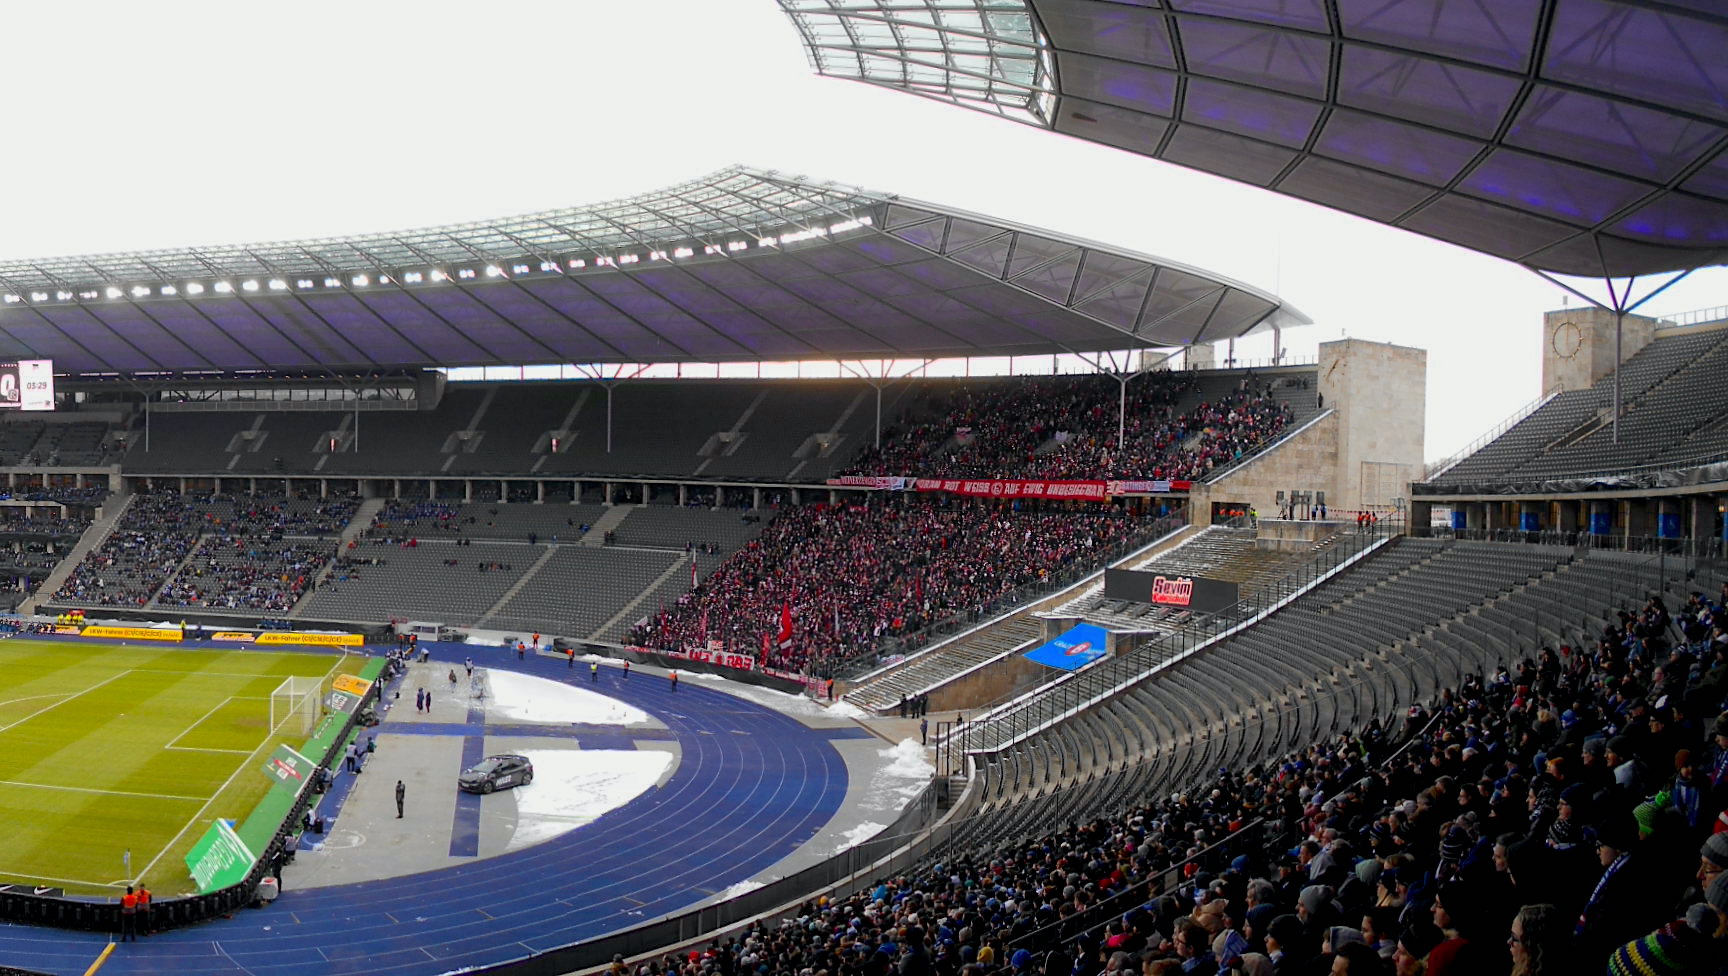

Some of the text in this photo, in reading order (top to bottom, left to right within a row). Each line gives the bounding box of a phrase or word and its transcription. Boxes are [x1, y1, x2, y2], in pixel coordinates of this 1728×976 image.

[963, 481, 990, 493] WEISS
[1004, 483, 1020, 495] AUF
[1153, 577, 1192, 596] Sevim
